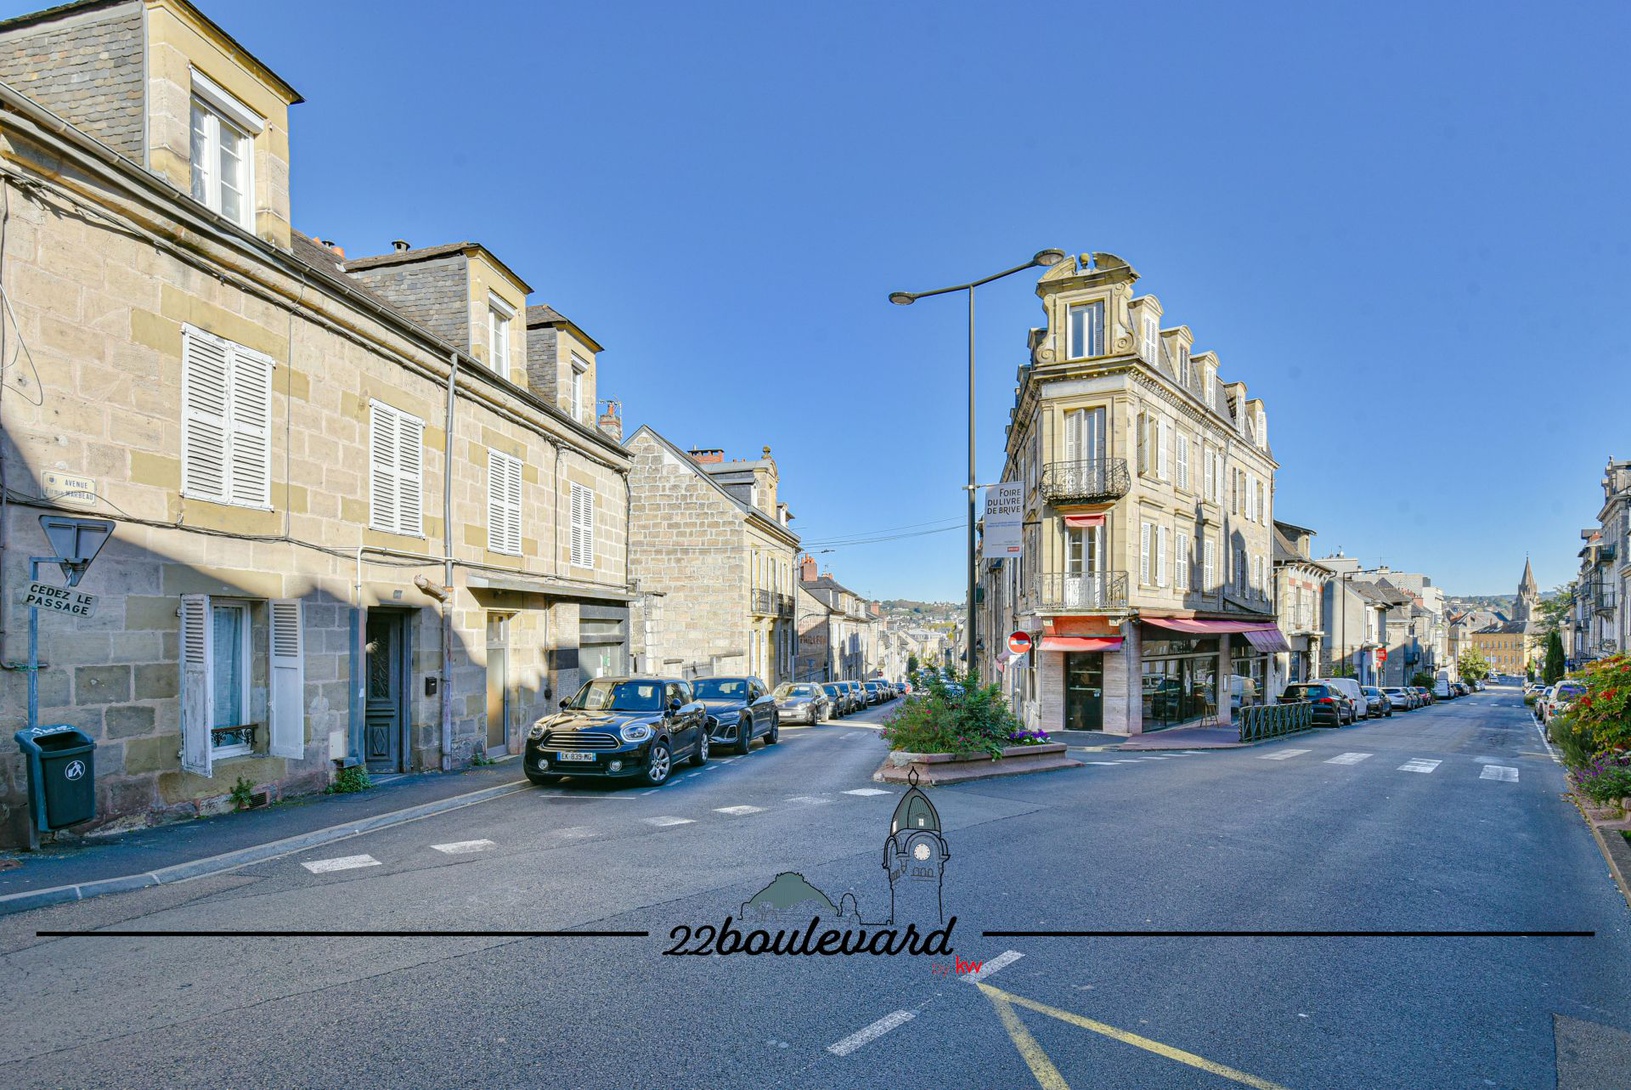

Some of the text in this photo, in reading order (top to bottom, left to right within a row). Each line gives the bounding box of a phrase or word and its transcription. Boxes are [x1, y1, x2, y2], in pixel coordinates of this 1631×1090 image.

[65, 479, 88, 489] AVENUE
[1000, 488, 1021, 497] FOIRE
[999, 497, 1021, 505] LIVRE
[999, 505, 1021, 515] BRIVE
[26, 594, 89, 615] PASSAGE
[77, 594, 93, 605] LE
